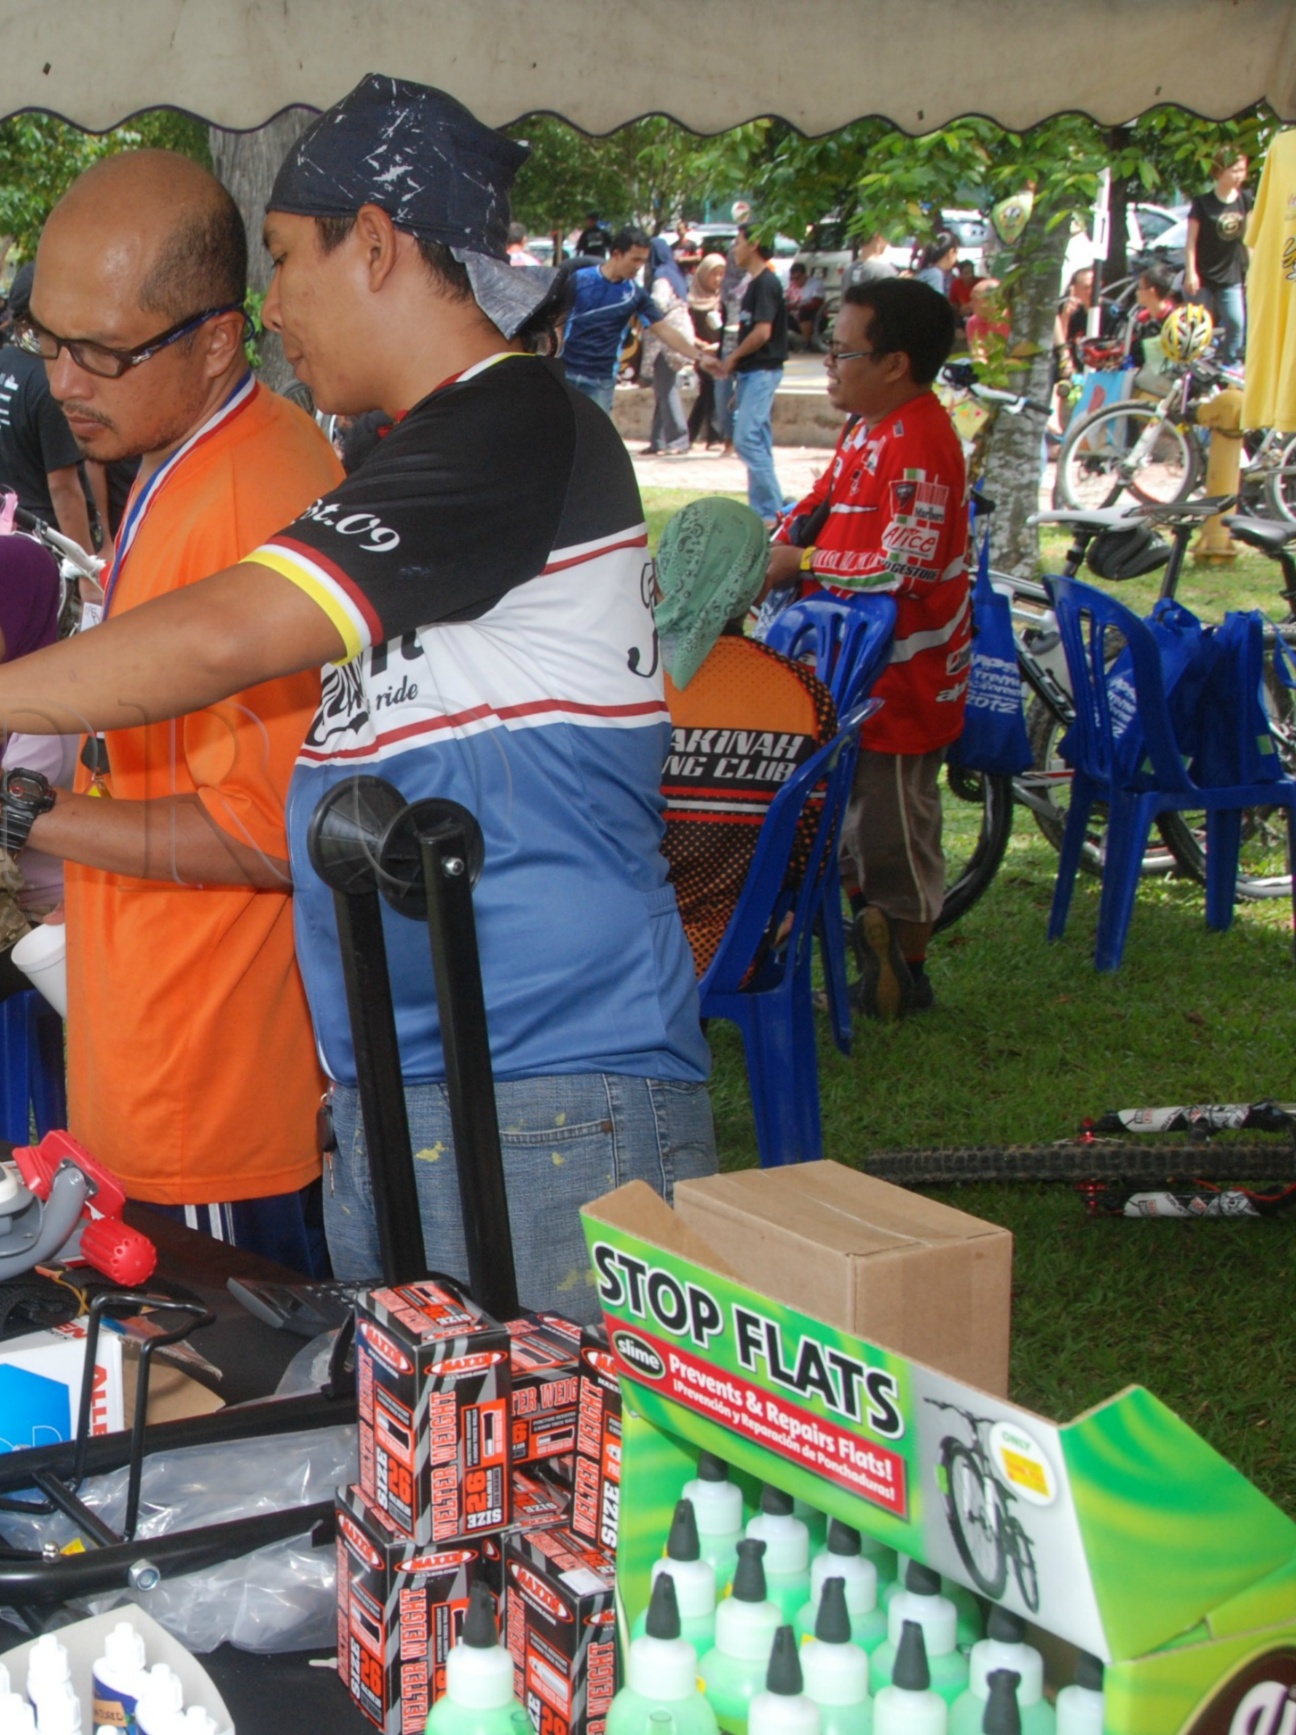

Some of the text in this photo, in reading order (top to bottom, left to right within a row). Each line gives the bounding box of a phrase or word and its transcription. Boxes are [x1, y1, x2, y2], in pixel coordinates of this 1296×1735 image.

[294, 498, 401, 553] st.09
[883, 525, 936, 553] Alice
[375, 675, 419, 712] ride
[670, 728, 805, 760] AKINAH
[712, 757, 798, 783] CLUB
[593, 1241, 904, 1440] STOP FLATS
[616, 1335, 663, 1372] slime
[668, 1351, 893, 1483] Prevents & Repairs Flats!
[429, 1390, 459, 1541] WELTER WEIGHT
[572, 1374, 604, 1540] WELTER WEIGHT
[732, 1410, 742, 1425] y
[802, 1443, 817, 1463] de
[816, 1450, 896, 1502] Ponchaduras!
[466, 1470, 487, 1513] 26
[467, 1508, 502, 1529] SIZE
[399, 1587, 427, 1660] WEIGHT
[586, 1641, 615, 1717] WEIGHT
